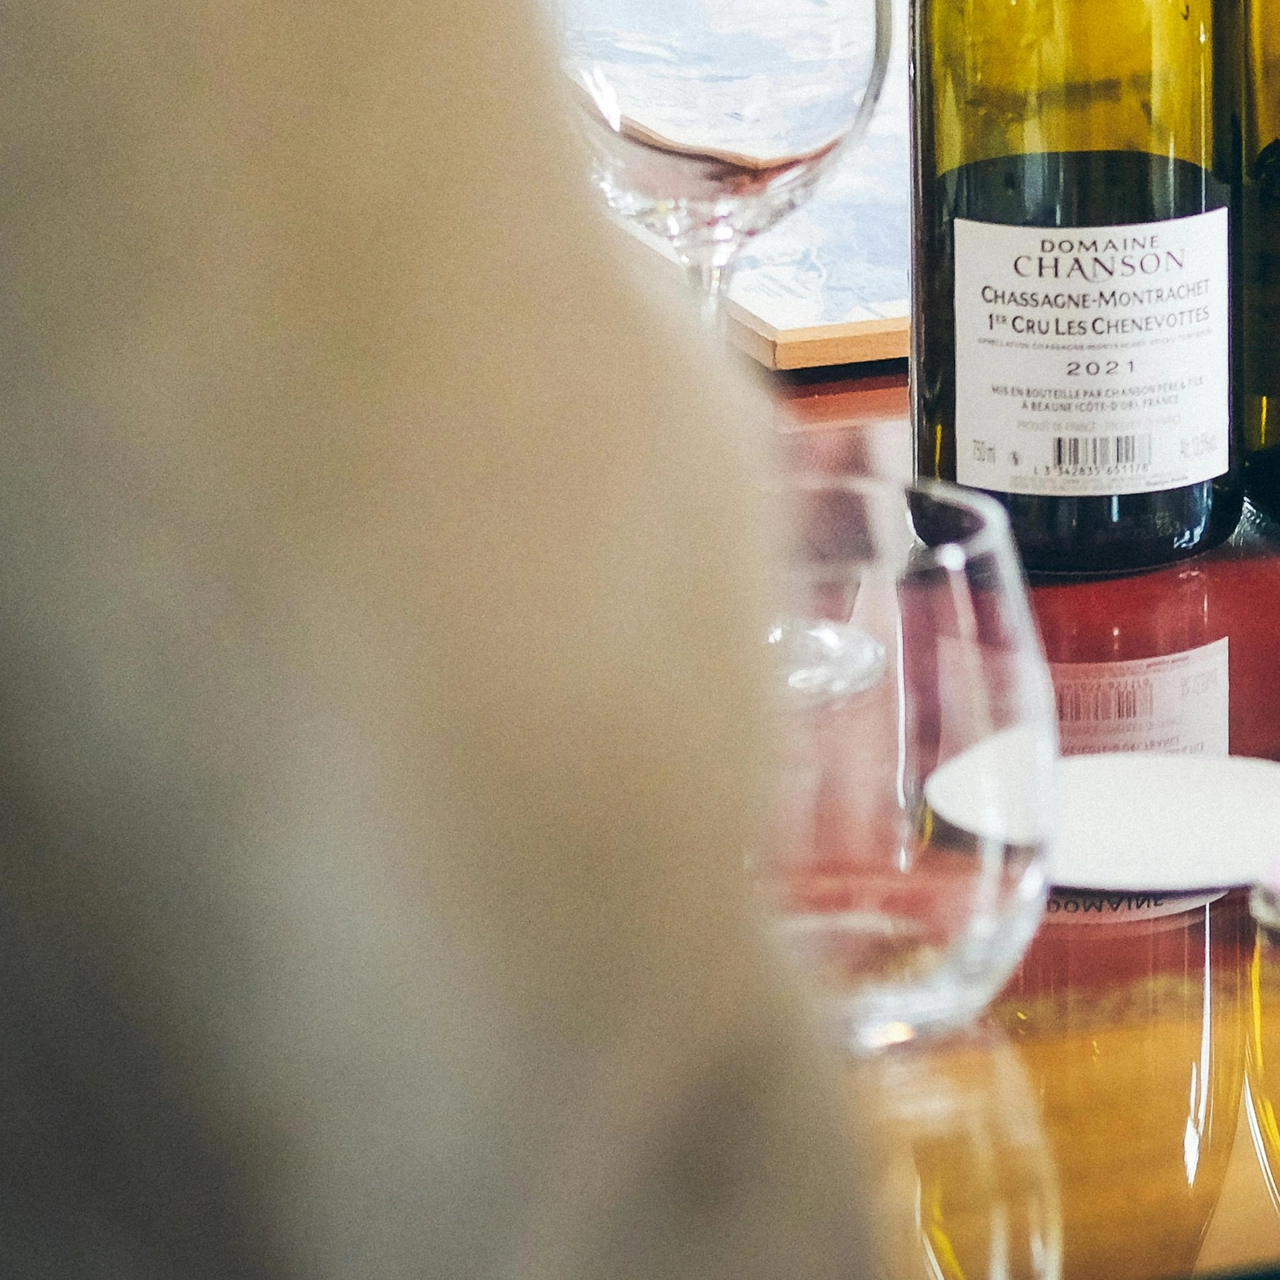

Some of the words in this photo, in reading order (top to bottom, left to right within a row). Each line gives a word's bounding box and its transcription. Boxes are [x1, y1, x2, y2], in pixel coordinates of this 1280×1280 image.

[1040, 235, 1160, 254] DOMAINE
[1013, 249, 1186, 284] CHANSON
[981, 278, 1211, 310] CHASSAGNE-MONTRACHET
[1012, 315, 1050, 336] CRU
[1055, 317, 1087, 337] LES
[1092, 305, 1210, 336] CHENEVOTTES
[1066, 360, 1135, 377] 2021
